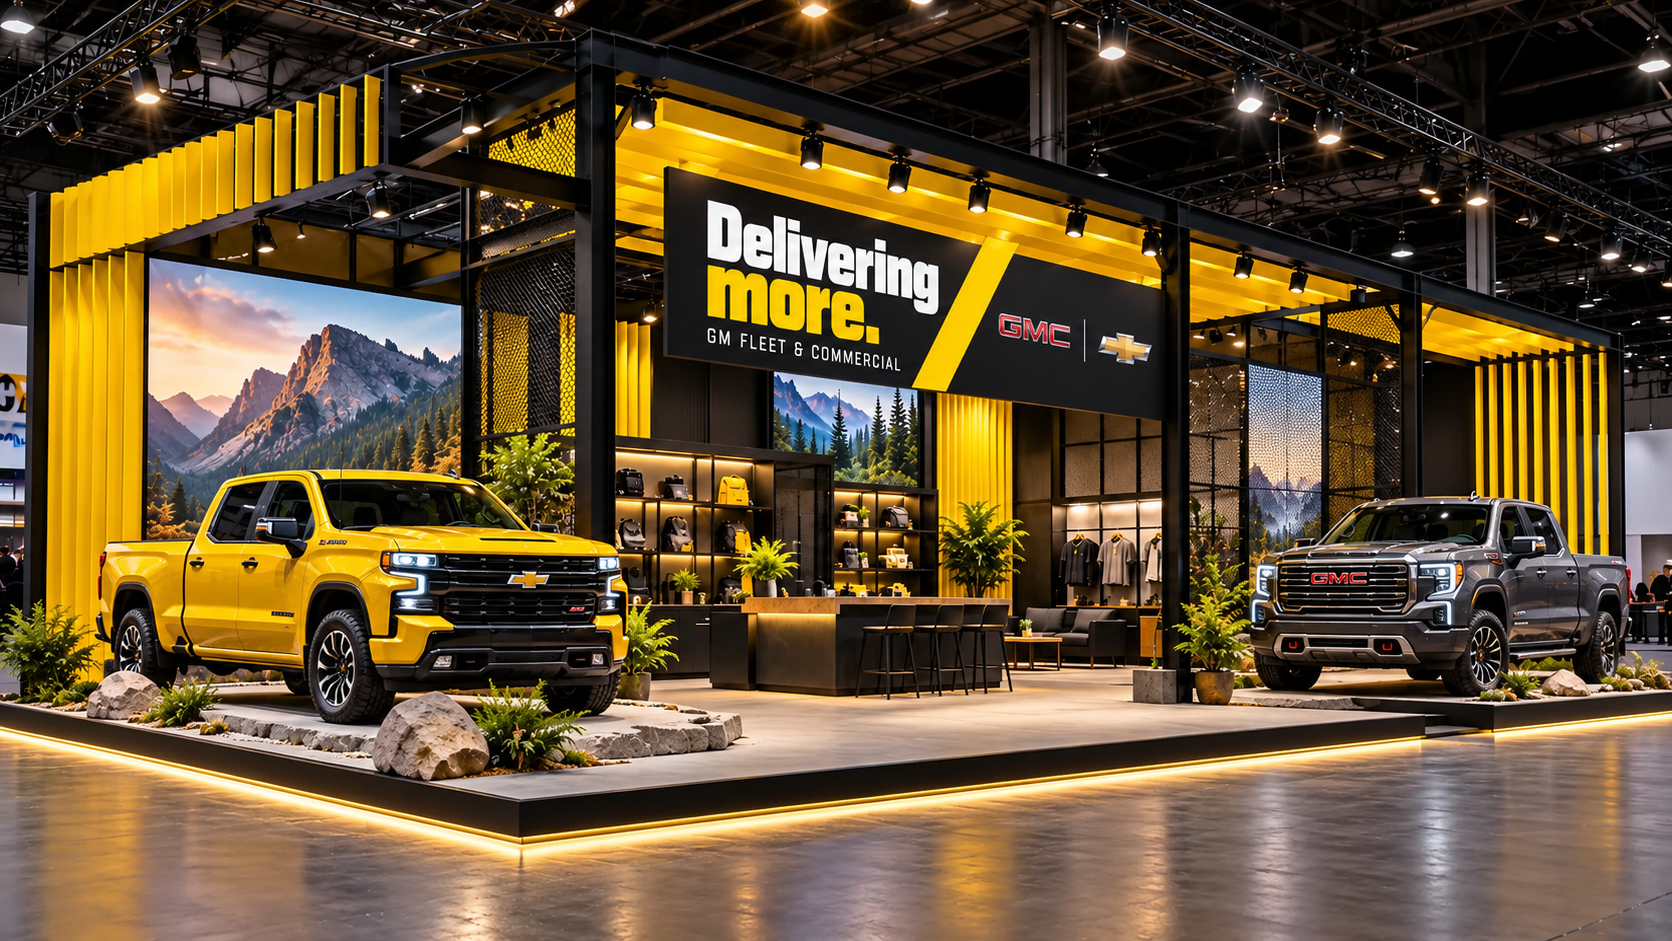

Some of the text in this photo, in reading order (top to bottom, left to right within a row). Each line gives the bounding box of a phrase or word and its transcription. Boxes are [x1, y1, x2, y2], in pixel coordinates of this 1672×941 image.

[707, 200, 939, 315] Delivering
[707, 265, 880, 345] more.
[707, 328, 901, 372] GM FLEET & COMMERCIAL
[998, 313, 1070, 348] GMC
[1311, 572, 1367, 584] GMC
